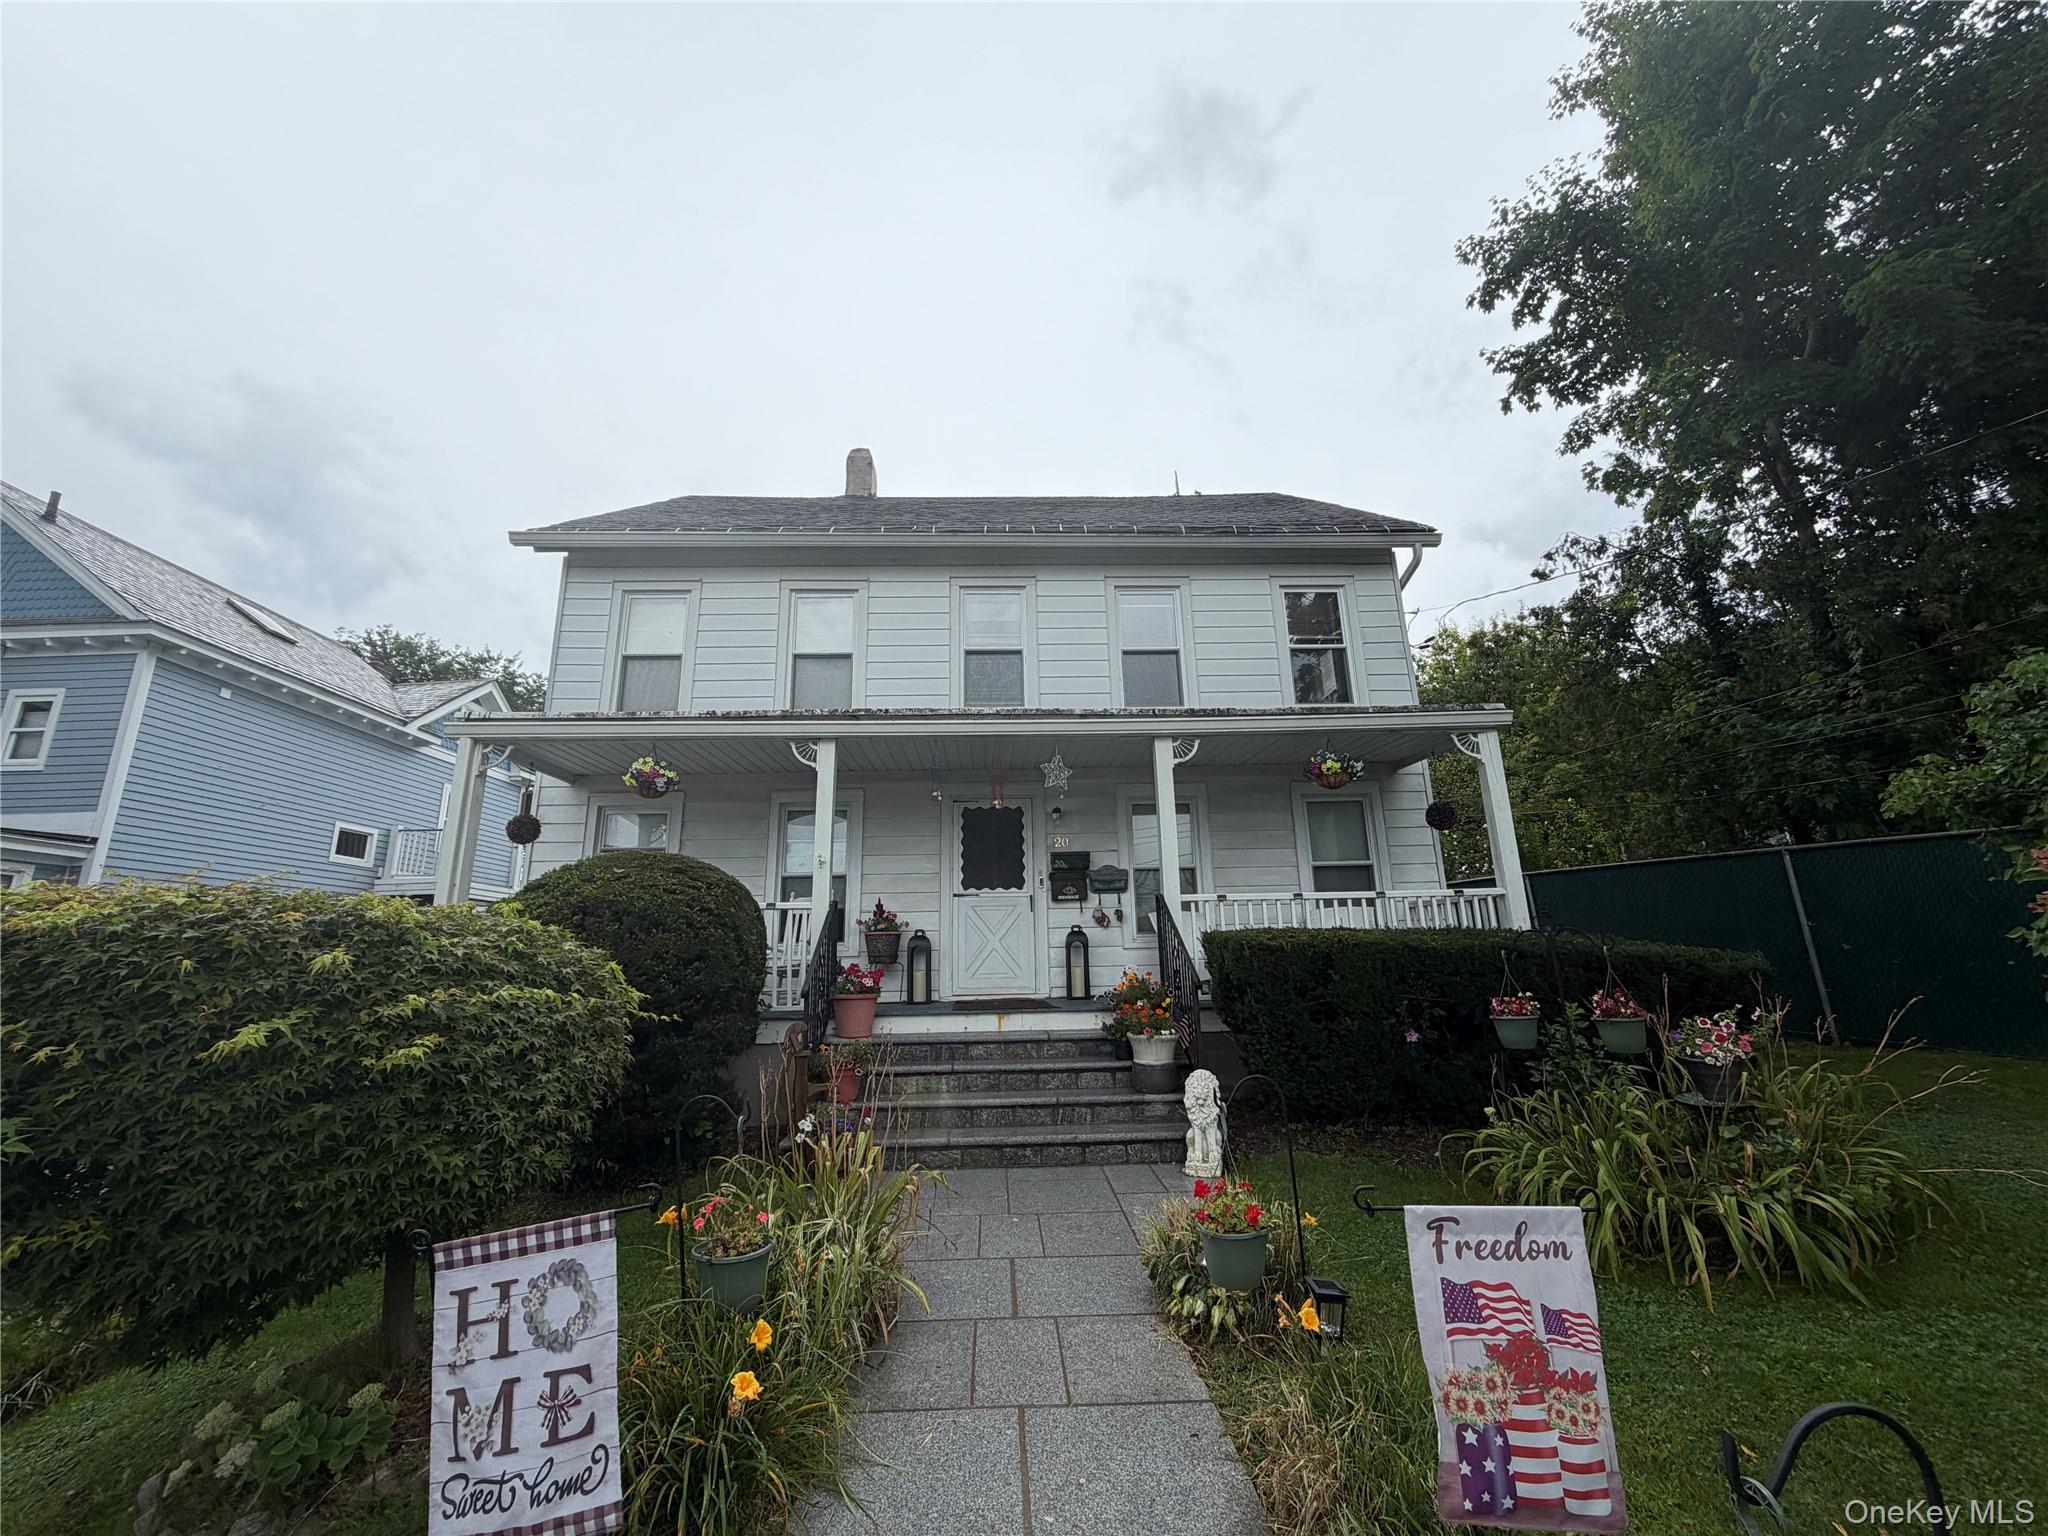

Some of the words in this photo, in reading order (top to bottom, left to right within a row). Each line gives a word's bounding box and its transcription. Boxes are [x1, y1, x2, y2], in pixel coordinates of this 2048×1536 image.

[1053, 836, 1069, 848] 20
[1426, 1215, 1573, 1265] Freedom
[441, 1469, 524, 1521] Sweet
[521, 1442, 610, 1510] home
